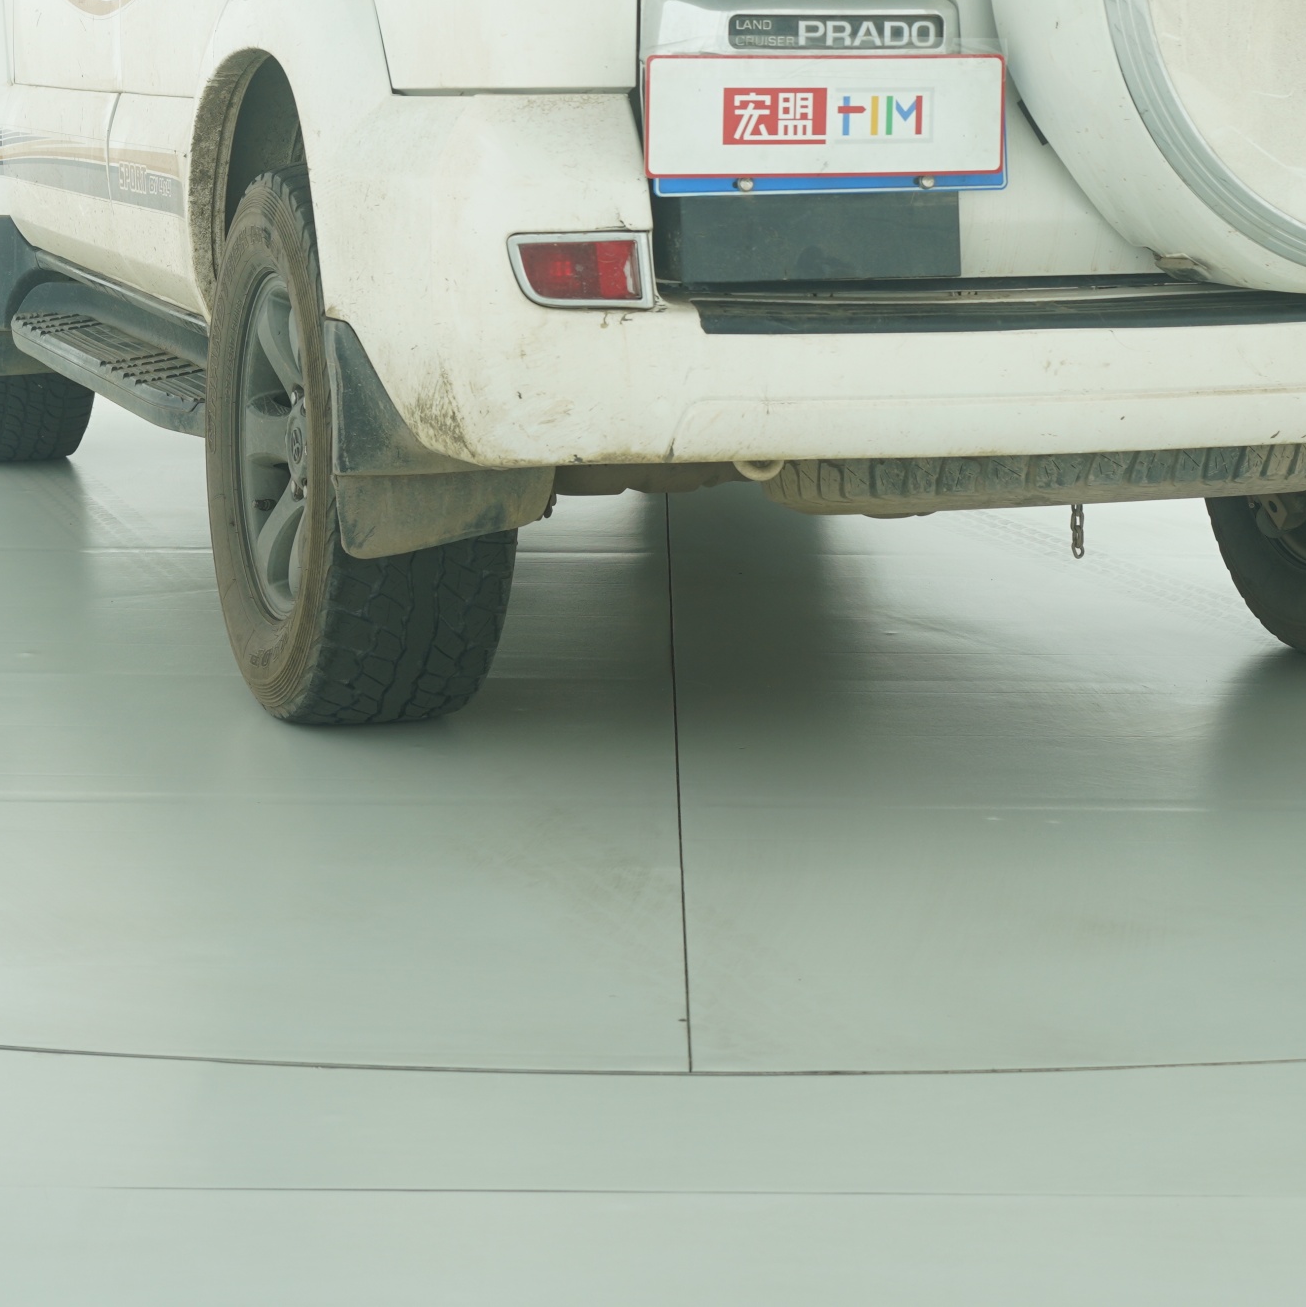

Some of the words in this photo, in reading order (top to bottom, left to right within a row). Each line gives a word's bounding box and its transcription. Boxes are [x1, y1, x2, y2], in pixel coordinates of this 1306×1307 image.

[735, 19, 772, 30] LAND
[797, 20, 936, 47] PRADO
[735, 35, 795, 46] CRUISER
[733, 92, 826, 140] 宏盟
[119, 161, 147, 194] SPORT
